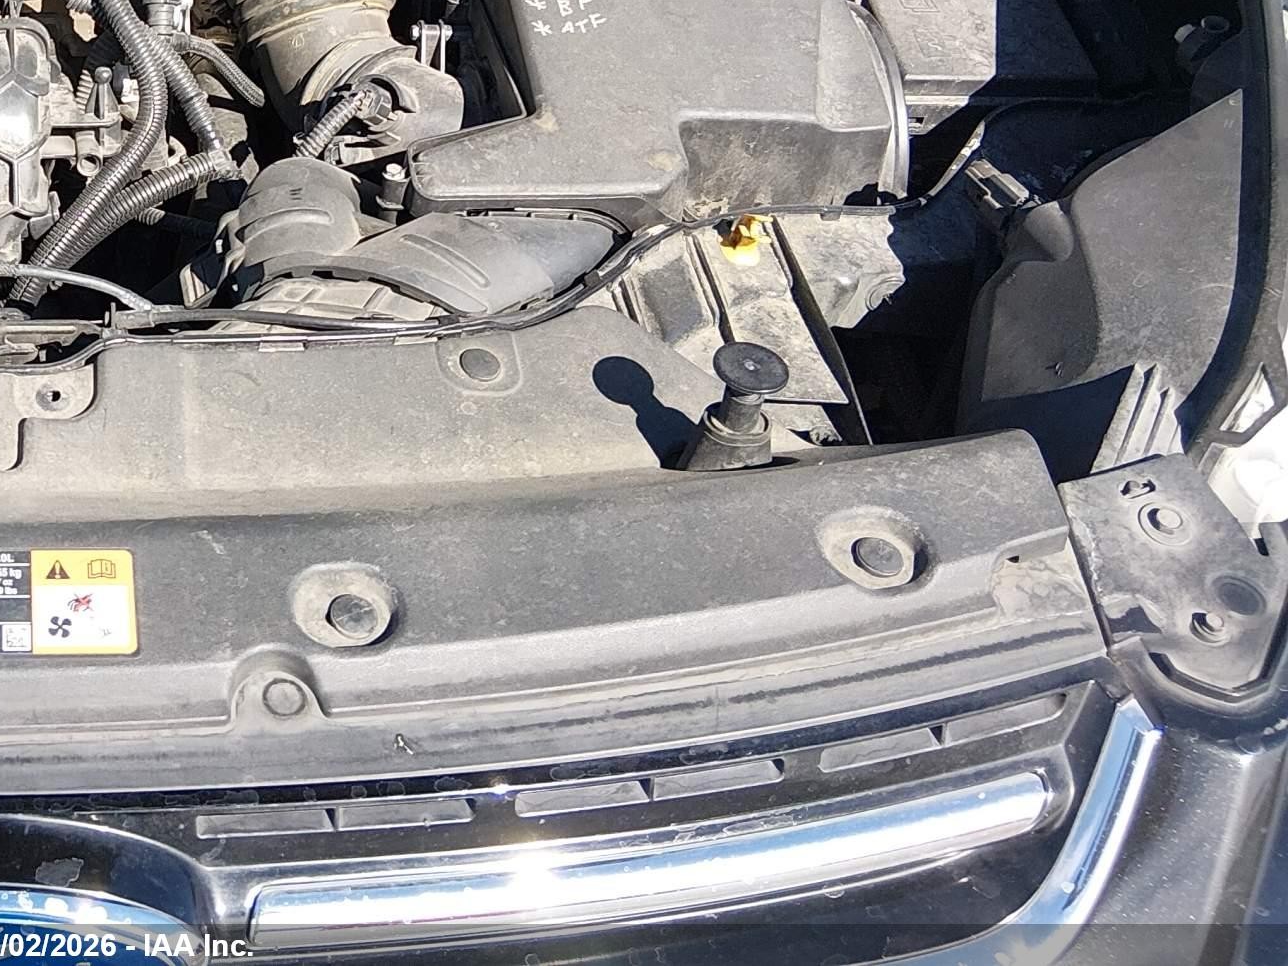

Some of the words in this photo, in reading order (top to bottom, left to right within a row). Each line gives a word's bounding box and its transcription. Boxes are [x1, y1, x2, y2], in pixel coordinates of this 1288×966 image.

[561, 13, 607, 33] ATF
[9, 567, 22, 579] kg
[2, 578, 13, 586] oz
[4, 586, 18, 595] lbs
